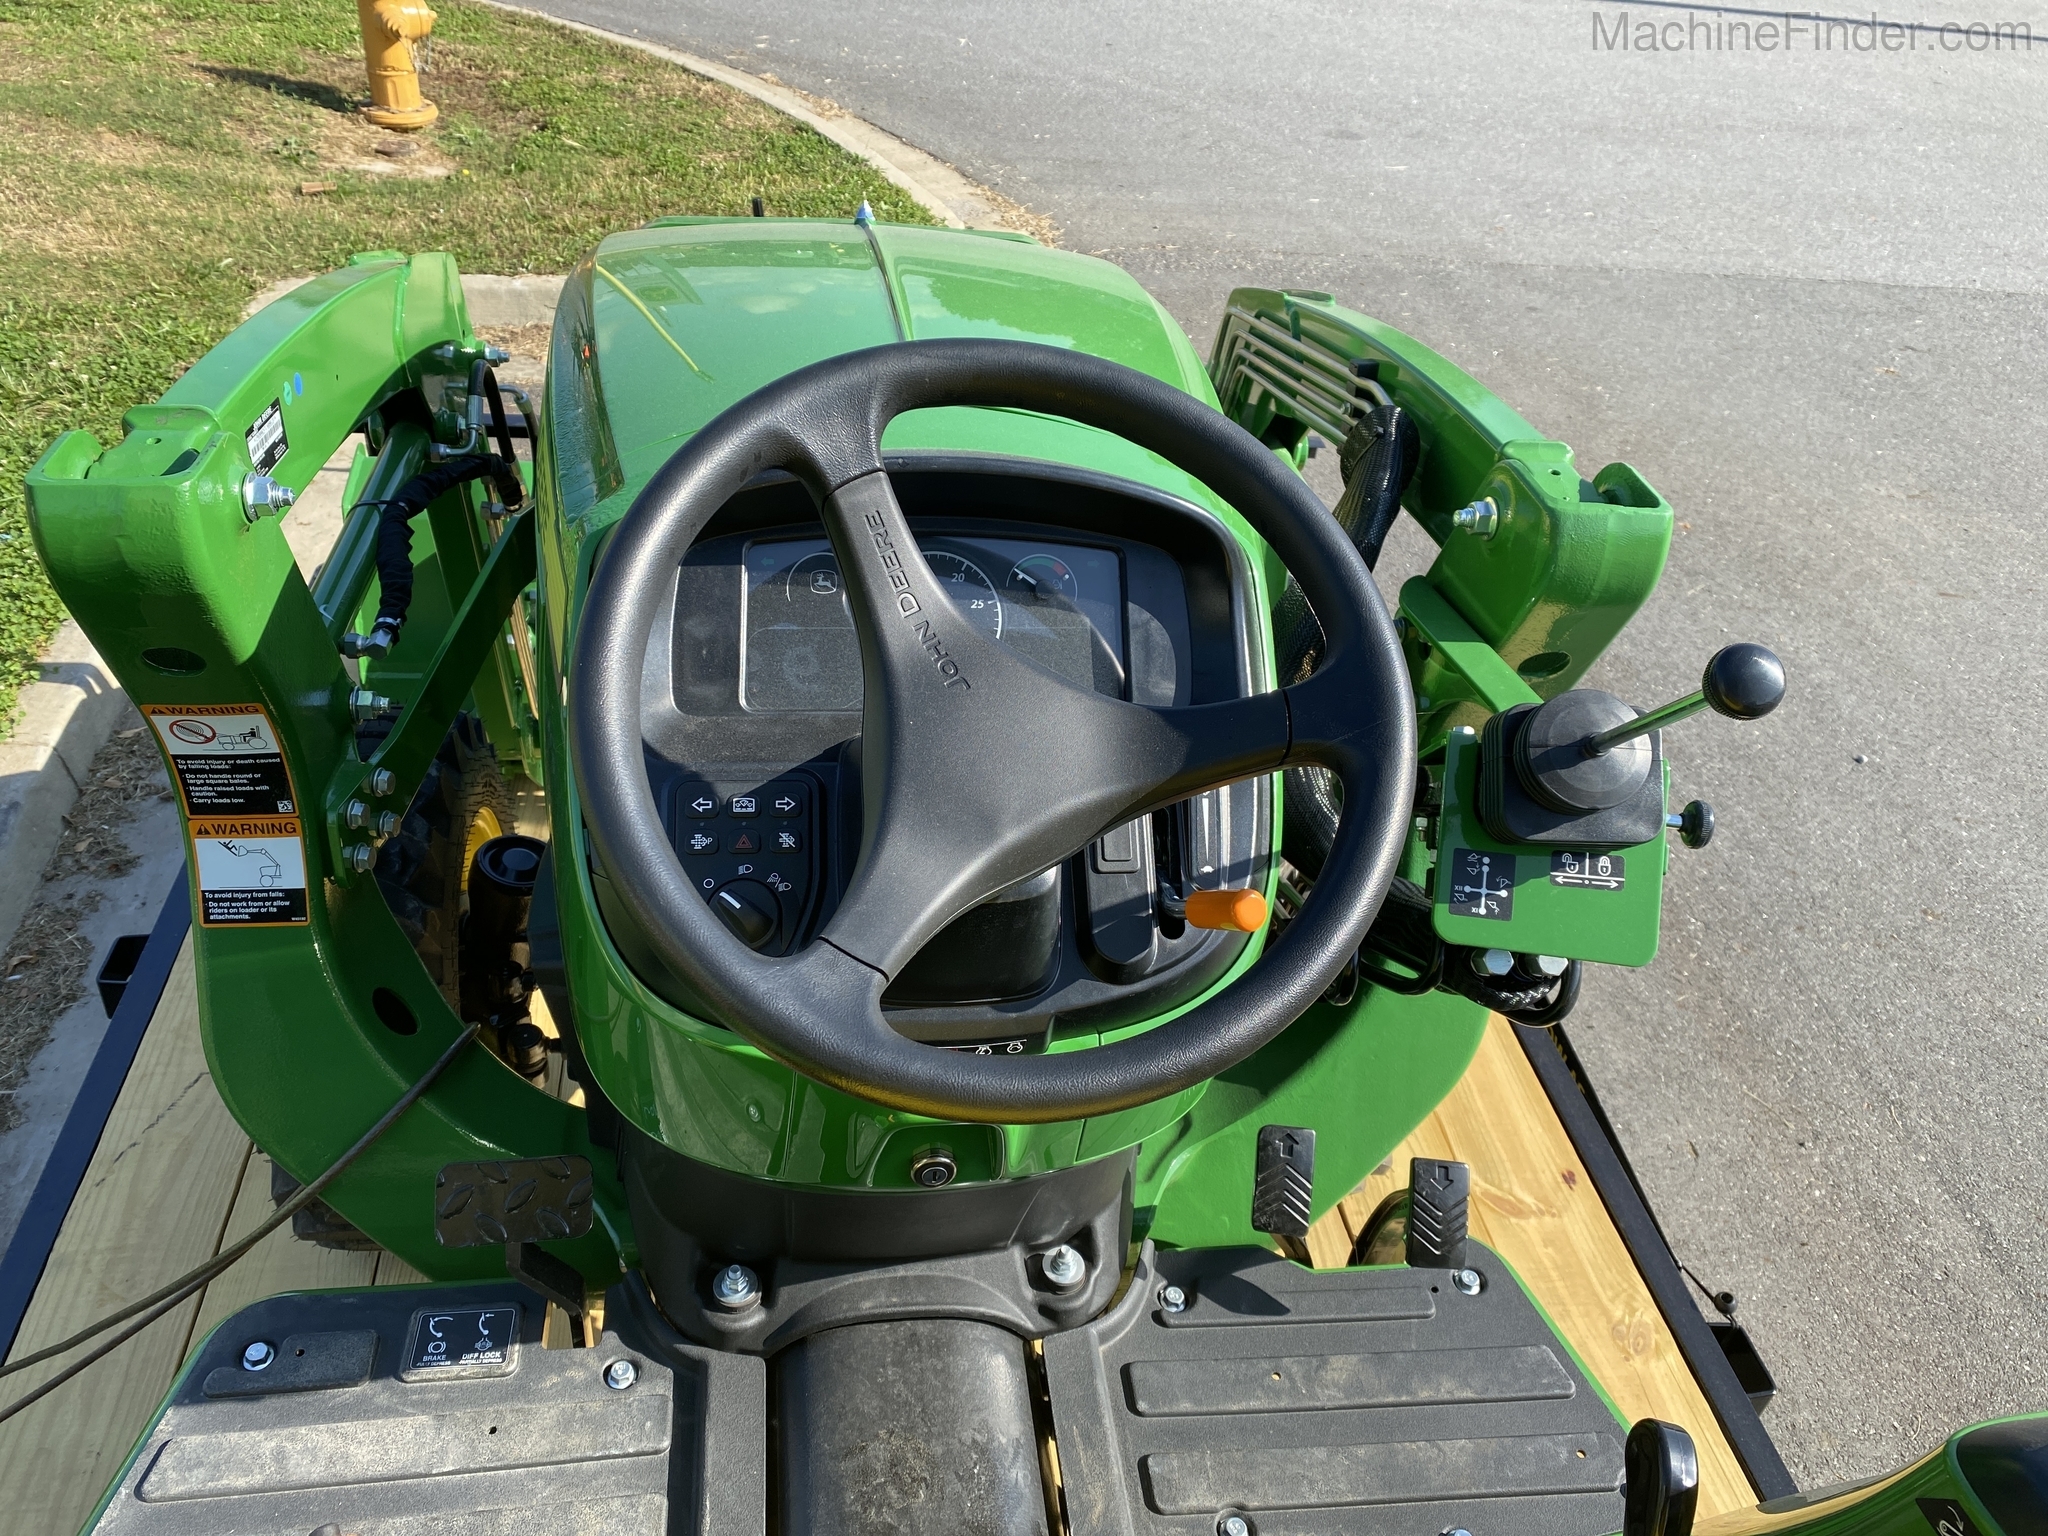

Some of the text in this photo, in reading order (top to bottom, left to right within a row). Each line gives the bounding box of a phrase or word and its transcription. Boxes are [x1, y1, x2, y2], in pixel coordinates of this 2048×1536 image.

[951, 572, 965, 582] 20
[864, 509, 971, 691] JOHN DEERE
[970, 599, 985, 609] 25
[165, 705, 260, 715] WARNING
[211, 822, 297, 835] WARNING
[232, 891, 251, 899] injury
